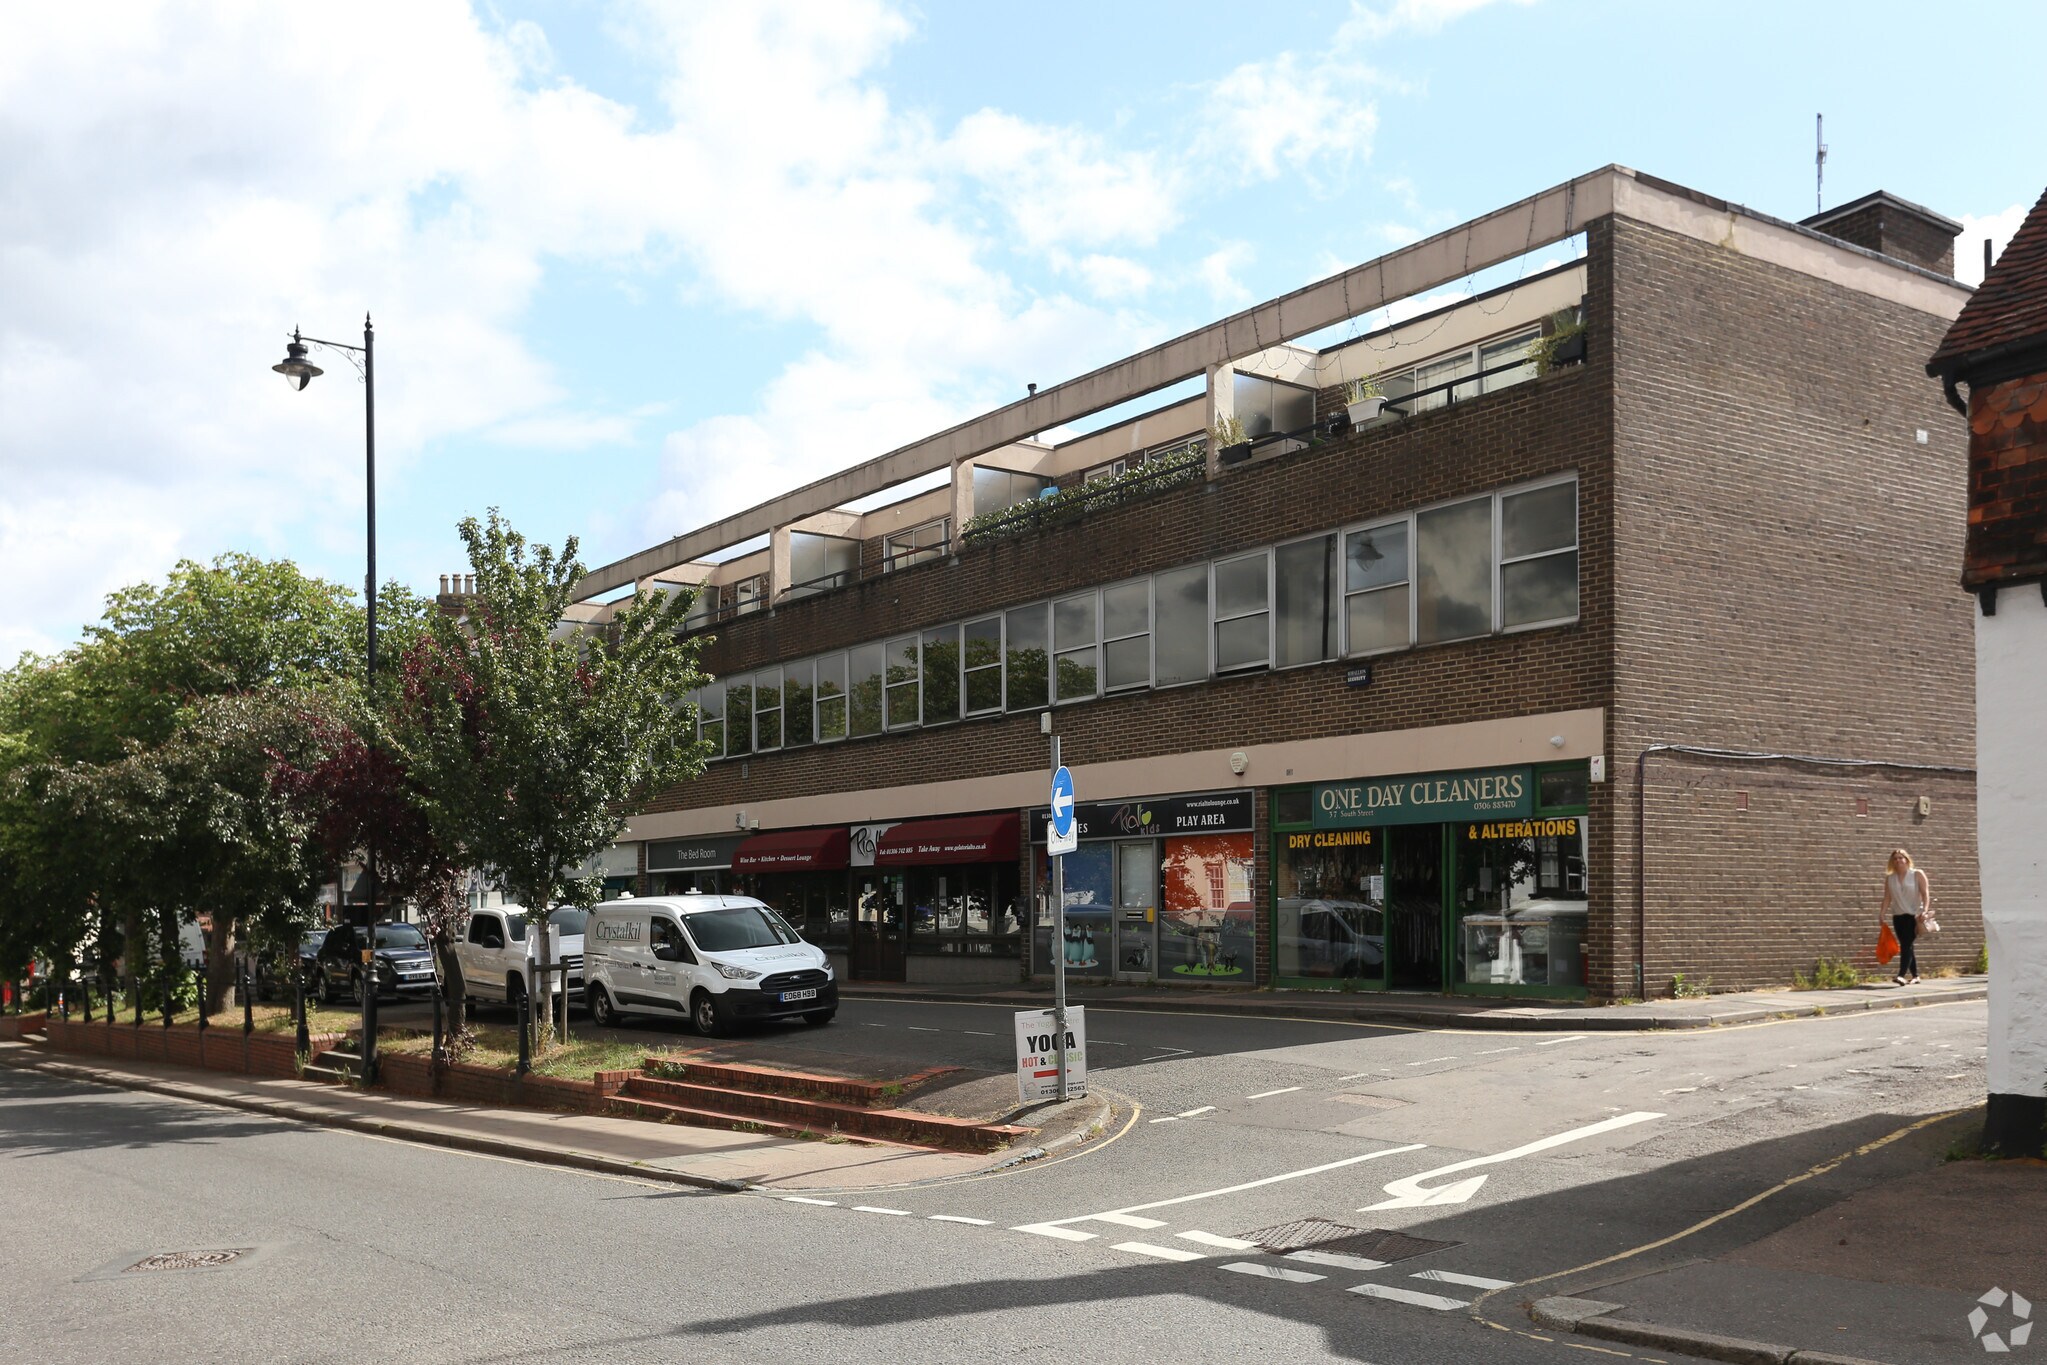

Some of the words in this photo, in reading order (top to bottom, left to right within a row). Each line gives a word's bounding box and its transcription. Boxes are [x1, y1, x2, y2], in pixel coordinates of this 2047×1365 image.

[1320, 787, 1363, 811] ONE
[1367, 784, 1406, 808] DAY
[1410, 774, 1523, 804] CLEANERS
[1186, 798, 1240, 808] www.rialtolounge.co.uk
[1340, 809, 1357, 818] South
[1358, 808, 1374, 816] Street
[1176, 815, 1198, 827] PLAY
[1200, 813, 1226, 825] AREA
[1468, 824, 1478, 839] &
[1481, 819, 1577, 839] ALTERATIONS
[1289, 834, 1312, 848] DRY
[1314, 830, 1371, 847] CLEANING
[677, 850, 688, 860] The
[688, 849, 700, 859] Bed
[700, 849, 717, 859] Room
[918, 845, 929, 853] Take
[928, 844, 941, 853] Away
[796, 853, 812, 862] Lounge
[596, 920, 641, 943] Crystalkil
[1022, 1056, 1038, 1068] HOT
[1040, 1057, 1046, 1066] &
